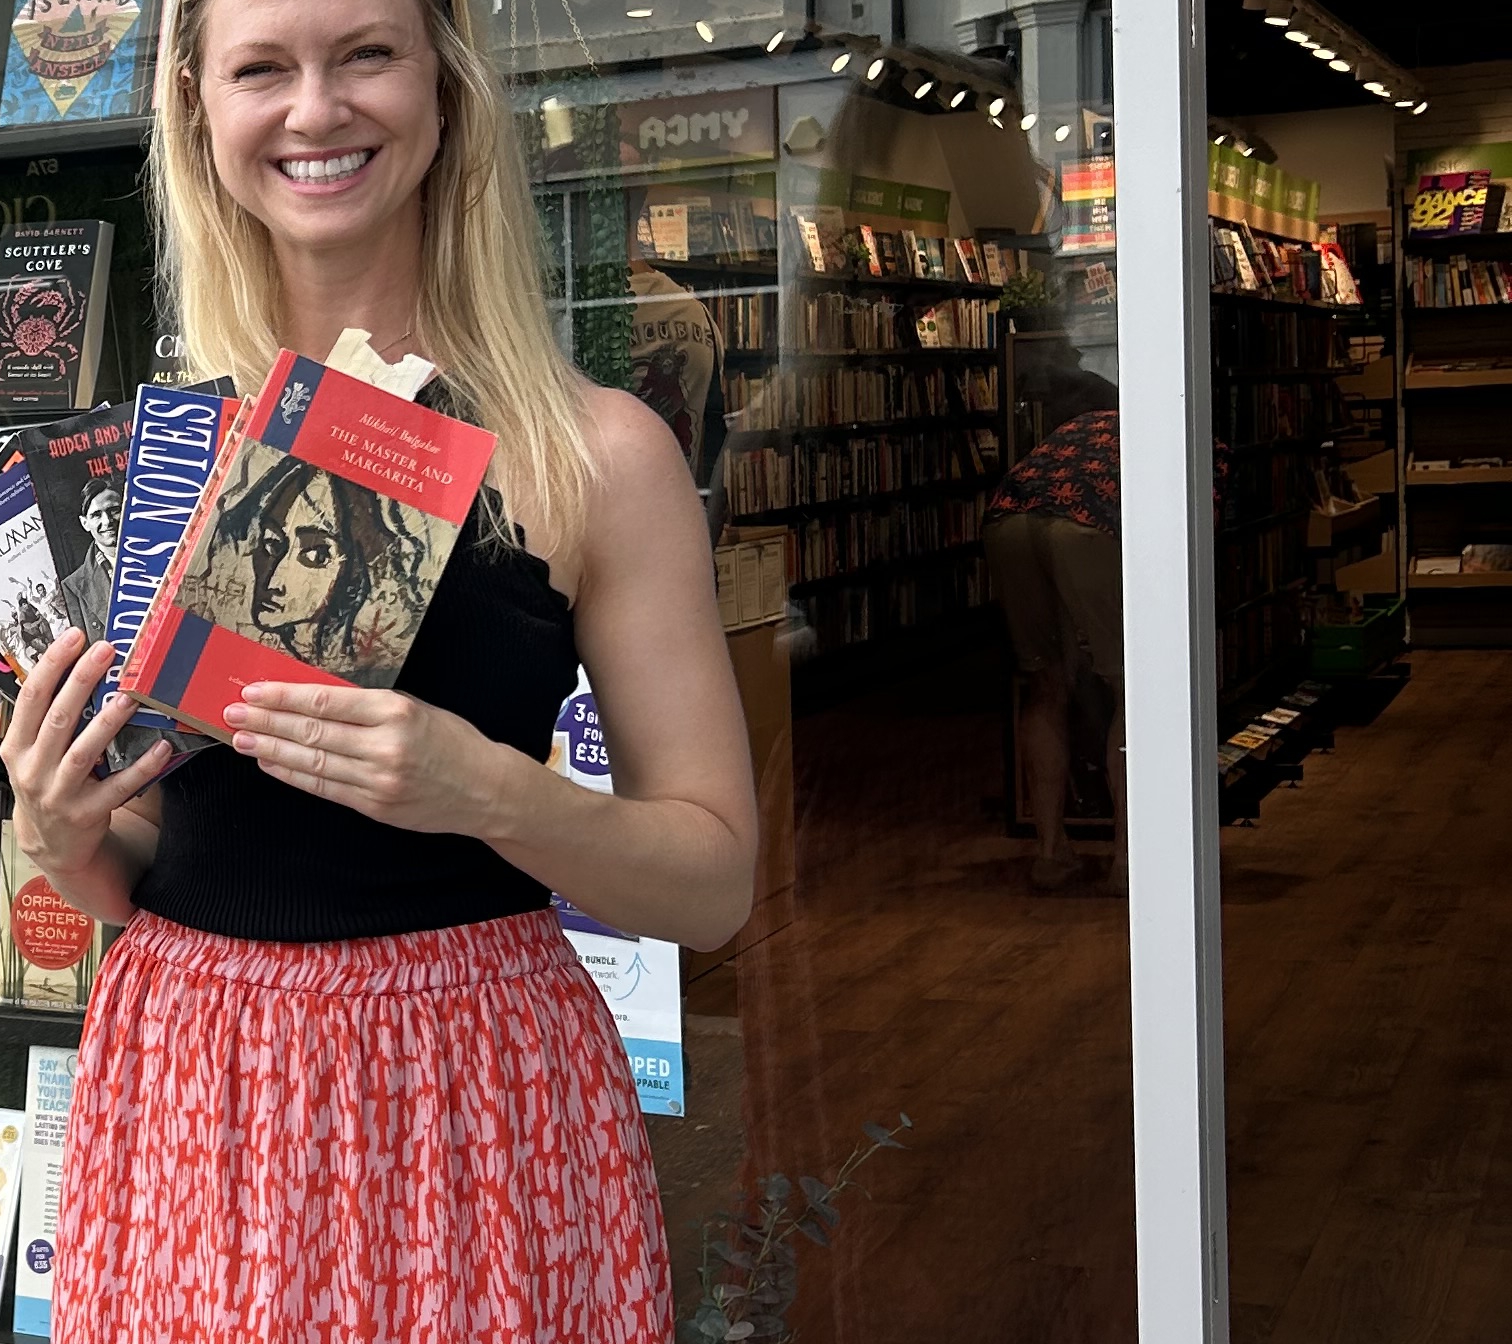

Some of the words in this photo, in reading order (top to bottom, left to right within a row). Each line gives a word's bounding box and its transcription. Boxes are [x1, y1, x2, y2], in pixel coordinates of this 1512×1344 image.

[1413, 188, 1488, 209] DANCE
[1410, 205, 1452, 229] 92
[14, 230, 41, 238] DAVID
[43, 228, 85, 237] BARNETT
[4, 244, 91, 258] SCUTTLER'S
[25, 259, 64, 272] COVE
[1088, 275, 1113, 290] ONE
[330, 425, 360, 446] THE
[361, 439, 418, 472] MASTER
[421, 465, 454, 485] AND
[340, 449, 424, 493] MARGARITA
[574, 703, 587, 722] 3
[16, 909, 88, 926] MASTER'S
[35, 926, 67, 940] SON
[39, 1059, 59, 1072] SAY
[37, 1085, 57, 1099] YOU
